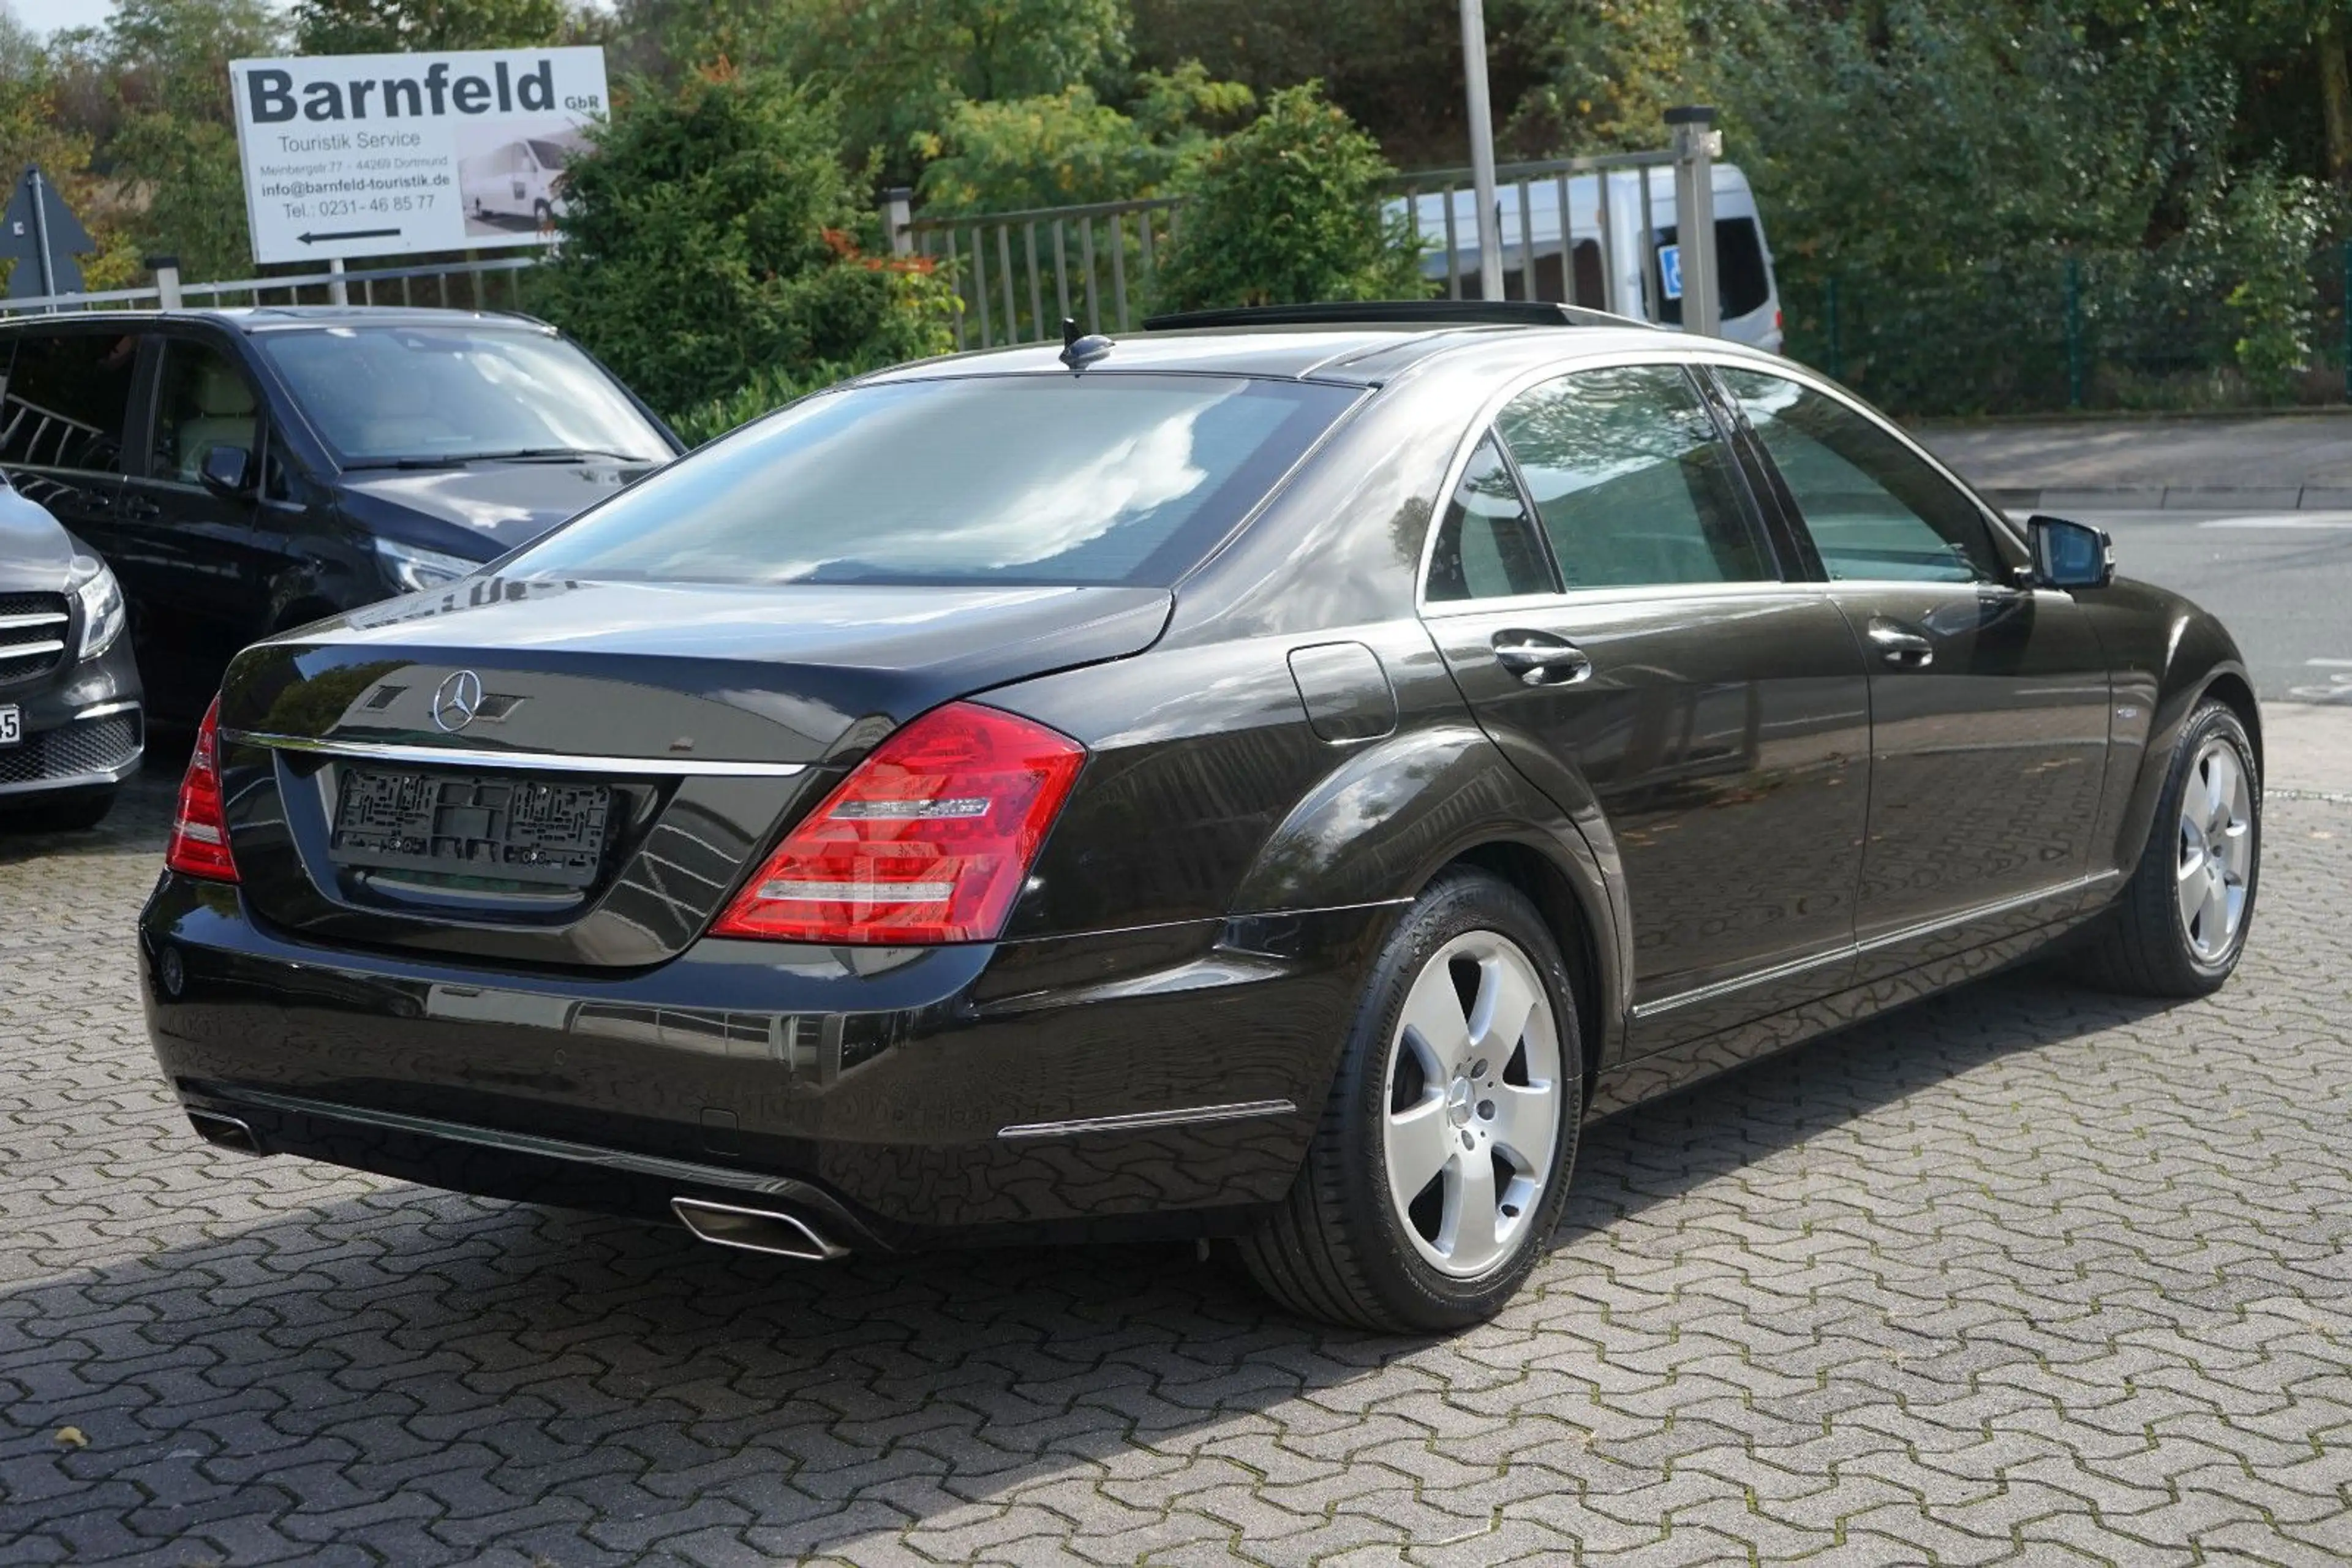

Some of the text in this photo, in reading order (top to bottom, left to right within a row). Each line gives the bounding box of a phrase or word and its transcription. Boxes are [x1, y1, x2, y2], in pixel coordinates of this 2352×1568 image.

[247, 59, 600, 123] Barnfeld GbR
[277, 132, 421, 152] Touristik Service
[394, 155, 448, 168] Dortmund
[262, 174, 450, 197] info@barnfeld-touristik.de
[370, 197, 389, 213] 46
[393, 195, 412, 211] 85
[417, 194, 434, 209] 77
